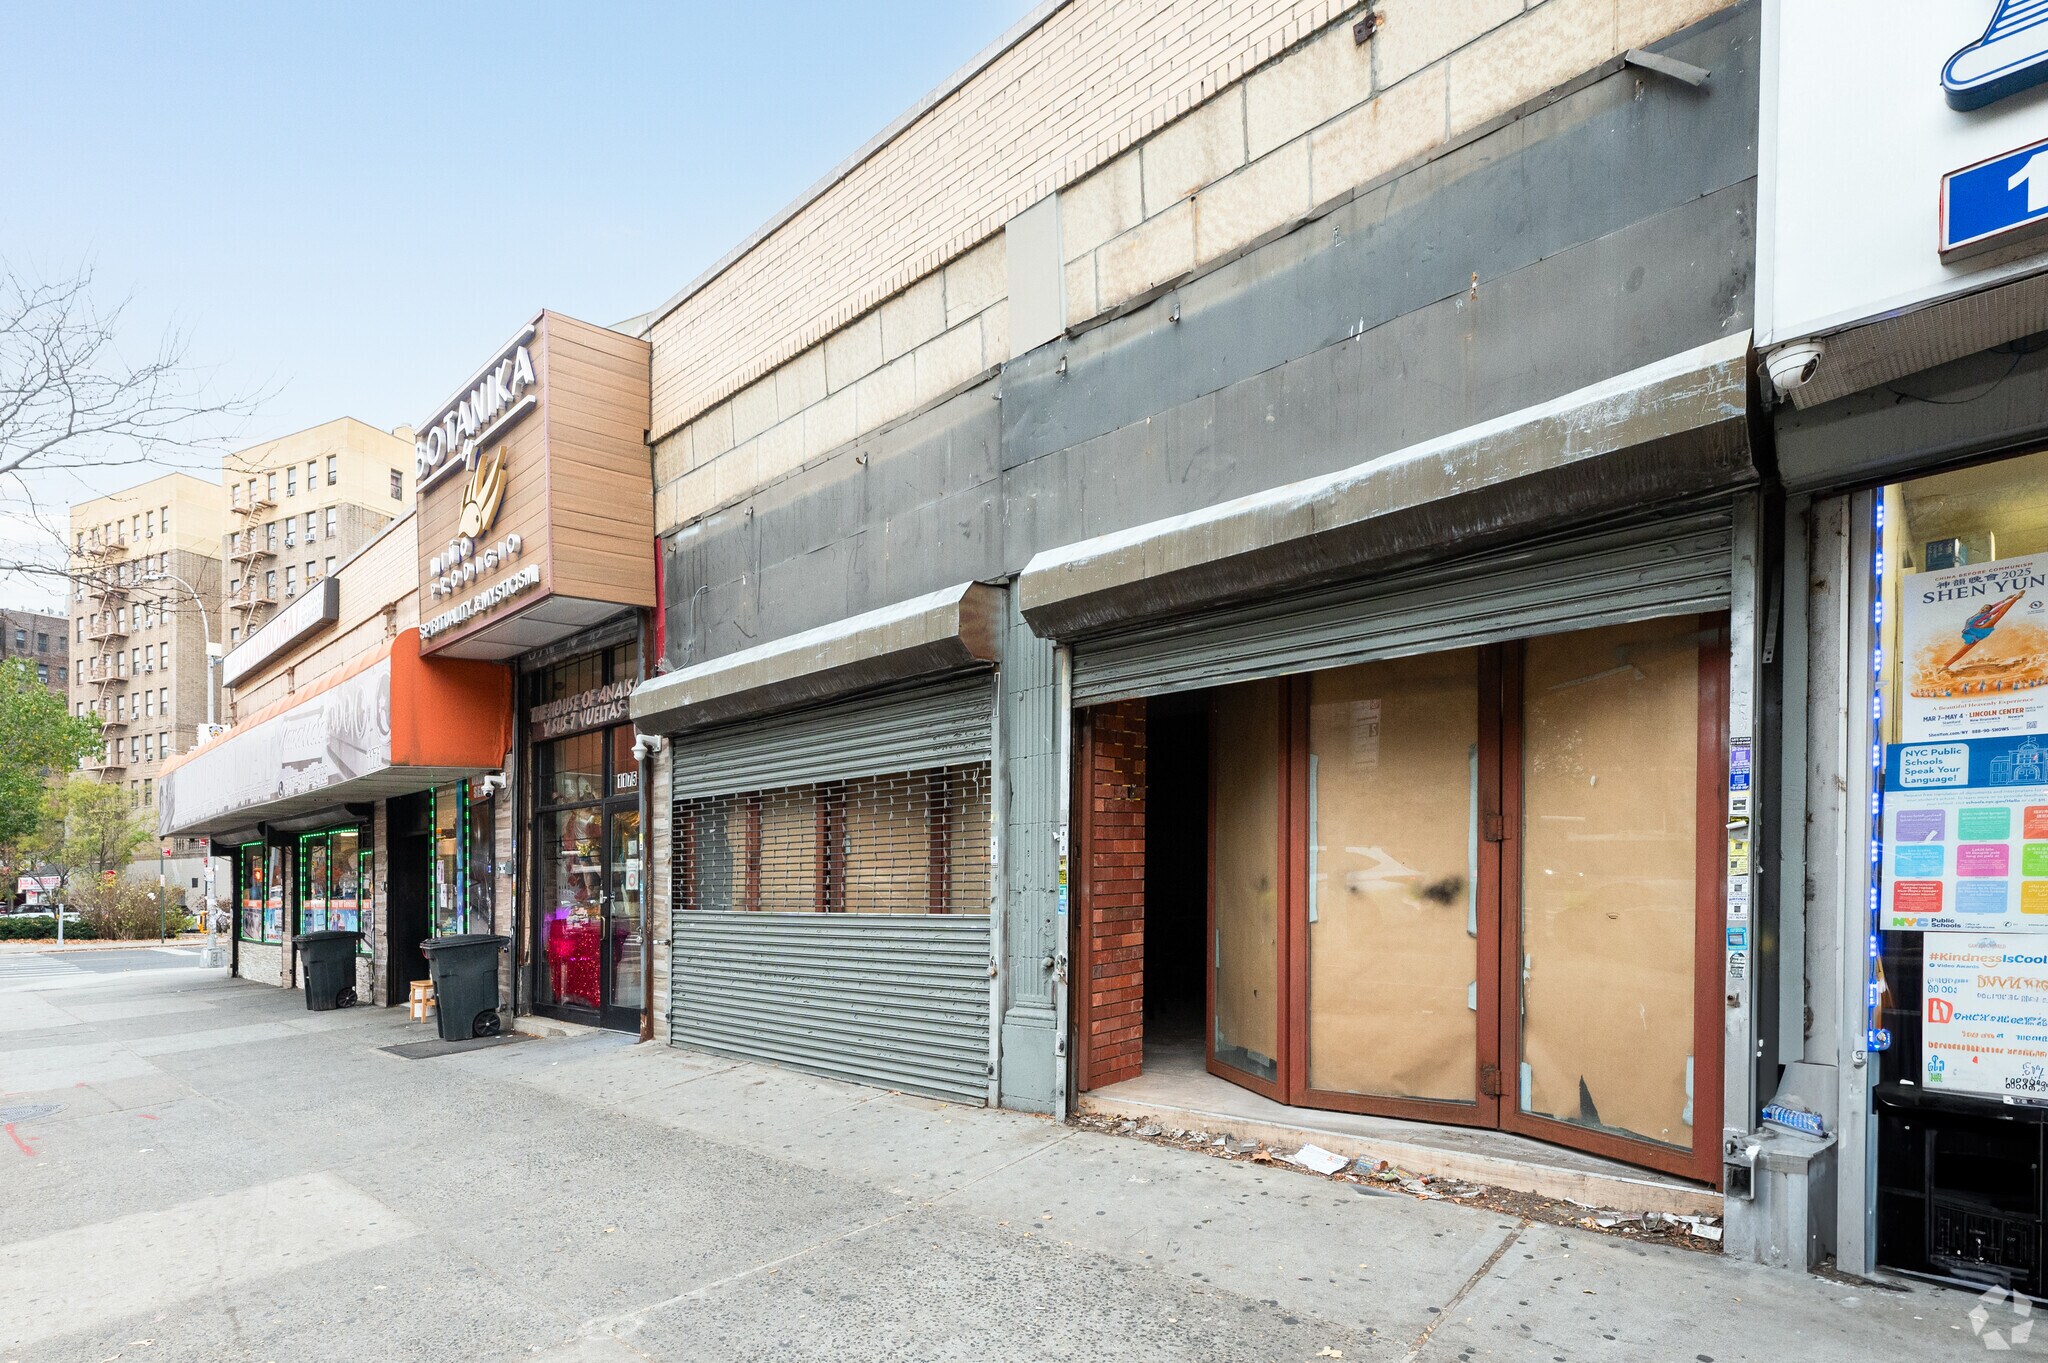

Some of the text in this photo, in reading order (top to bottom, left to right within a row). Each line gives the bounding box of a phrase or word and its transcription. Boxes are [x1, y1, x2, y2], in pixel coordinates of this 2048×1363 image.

[416, 345, 535, 481] BOTANIKA
[430, 533, 521, 600] PRODIGIO
[1934, 562, 2034, 582] CHINA BEFORE COMMUNISM
[2002, 567, 2032, 580] 2025
[1922, 574, 2046, 604] SHEN YUN
[420, 598, 476, 640] SPIRITUALITY
[482, 564, 540, 607] MYSTICISM
[530, 704, 549, 723] THE
[548, 694, 582, 718] HOUSE
[581, 687, 600, 708] OF
[551, 714, 572, 736] SUS
[580, 700, 624, 728] VUELTAS
[1969, 710, 1997, 718] LINCOLN
[1998, 707, 2025, 716] CENTER
[1931, 748, 1962, 756] Public
[1905, 758, 1943, 766] Schools
[1904, 766, 1934, 776] Speak
[1904, 774, 1957, 784] Language!
[1892, 917, 1928, 926] NYC
[1928, 952, 2048, 964] #KindnessIsCool
